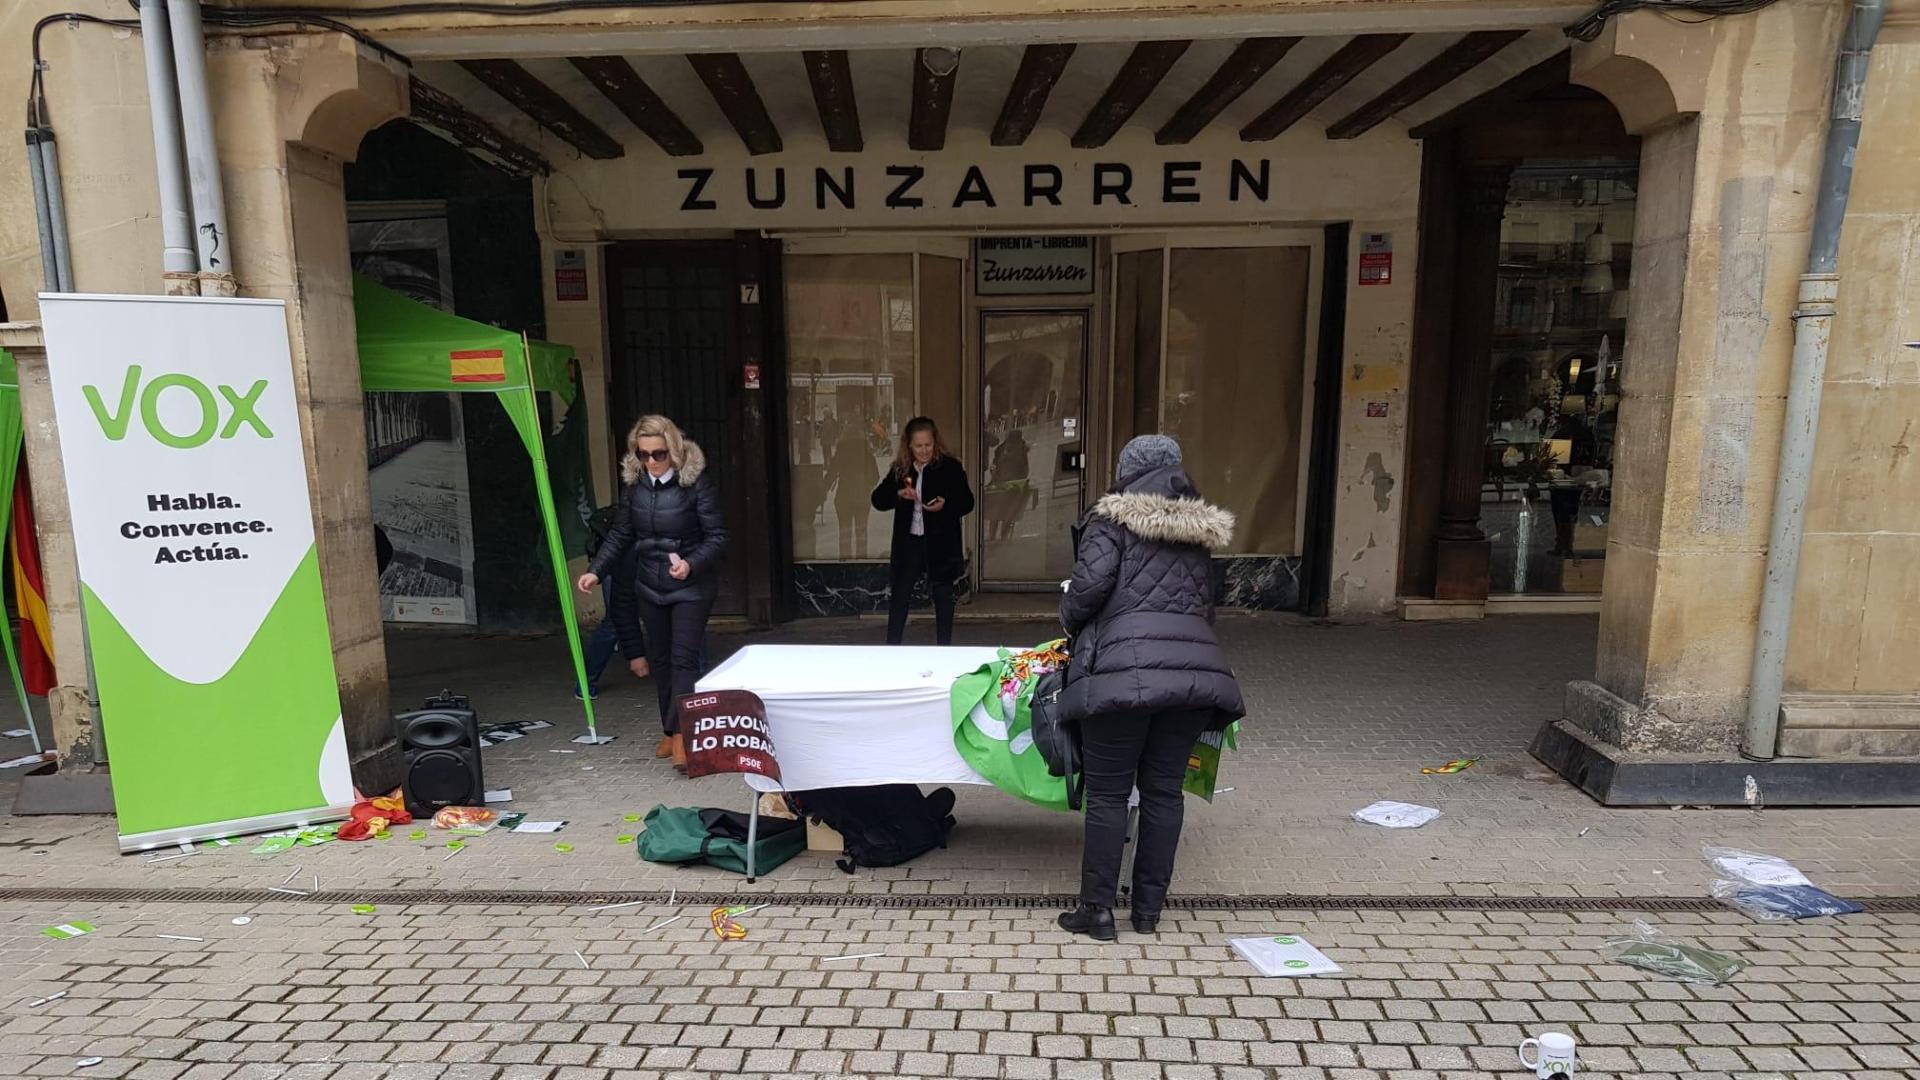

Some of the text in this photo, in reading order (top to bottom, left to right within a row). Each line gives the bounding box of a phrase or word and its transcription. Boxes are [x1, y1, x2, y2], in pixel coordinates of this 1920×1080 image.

[677, 159, 1270, 210] ZUNZARREN
[983, 259, 1087, 281] Zunzarren
[745, 286, 754, 301] 7
[82, 365, 274, 449] VOX
[147, 493, 241, 511] Habla.
[120, 520, 273, 539] Convence.
[154, 542, 248, 564] Actúa.
[686, 696, 716, 709] CCOO
[692, 736, 718, 752] LO
[740, 756, 761, 770] PSOE
